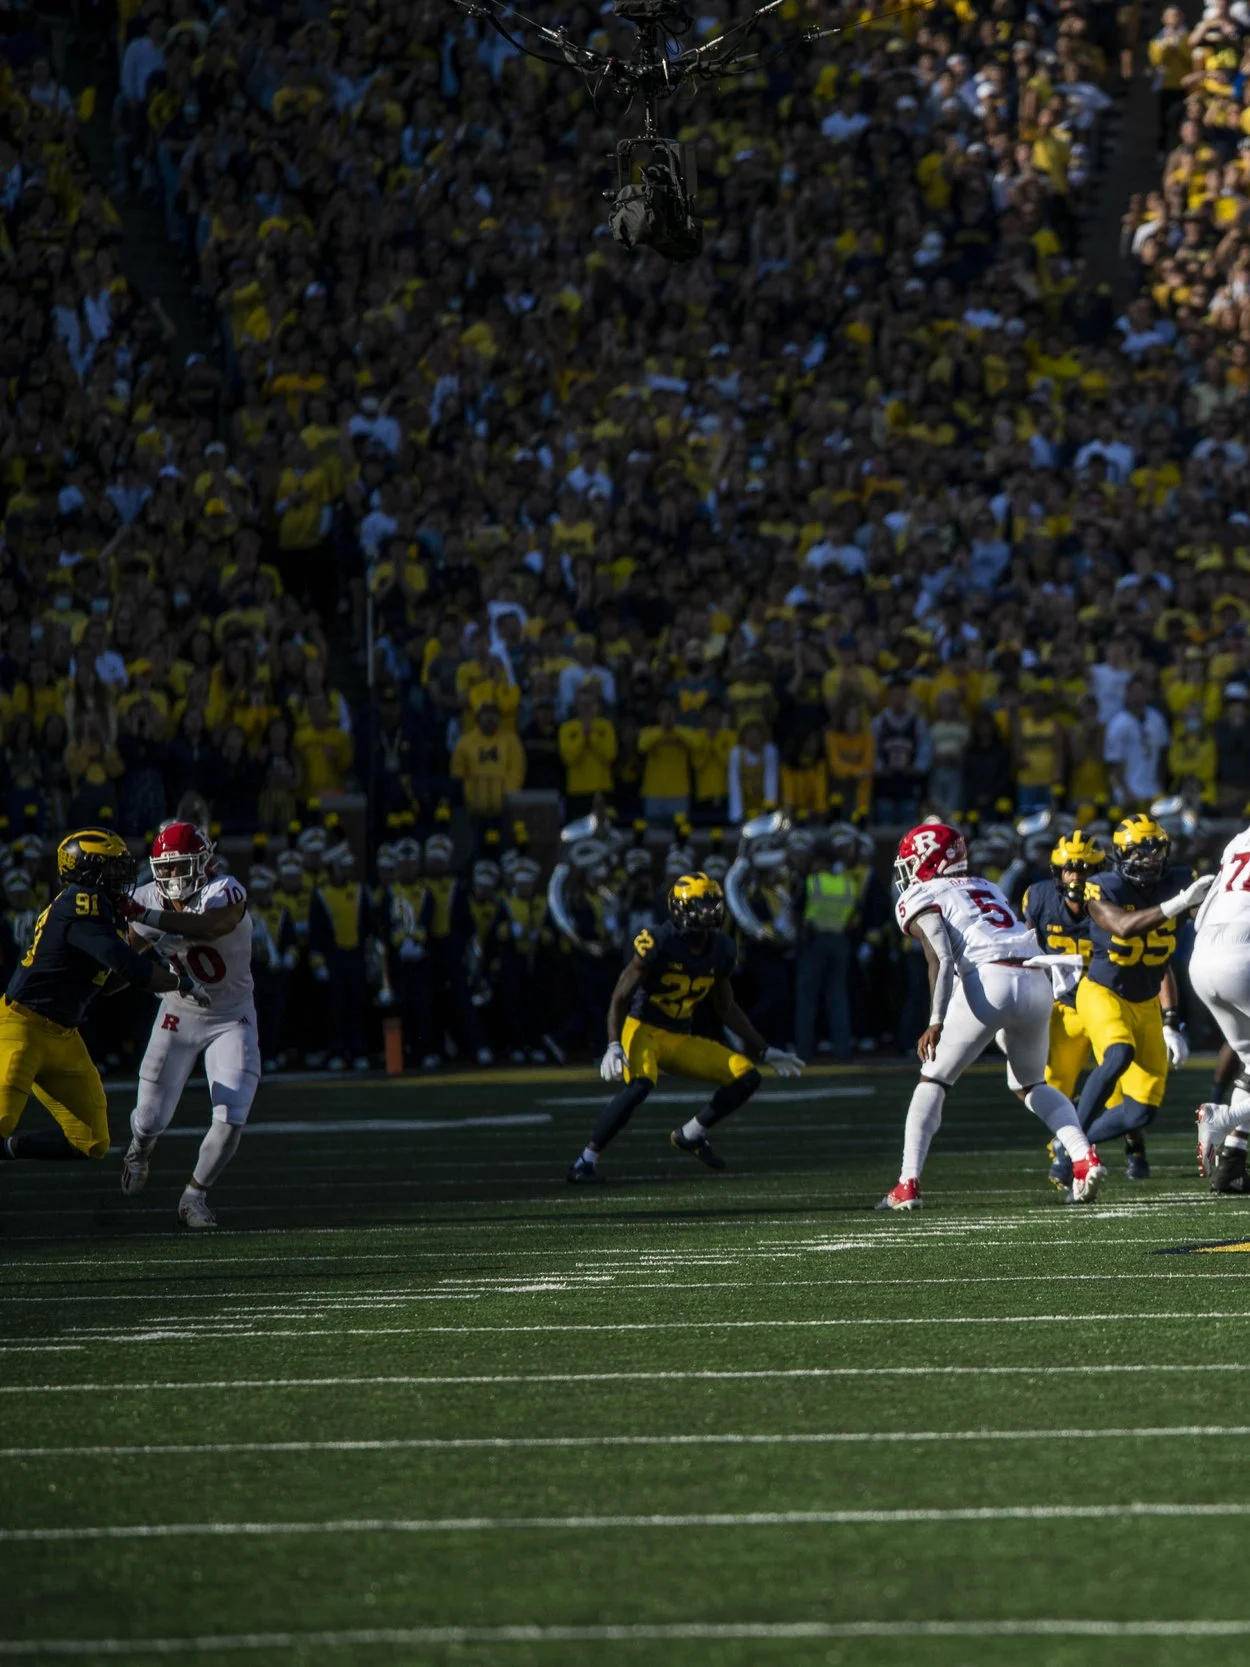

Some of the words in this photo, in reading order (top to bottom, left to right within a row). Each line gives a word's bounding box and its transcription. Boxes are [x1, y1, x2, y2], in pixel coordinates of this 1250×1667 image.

[913, 831, 940, 855] R
[75, 893, 99, 916] 91
[223, 887, 244, 905] 10
[899, 900, 907, 918] 5
[967, 889, 1015, 929] 5
[161, 1012, 181, 1033] R
